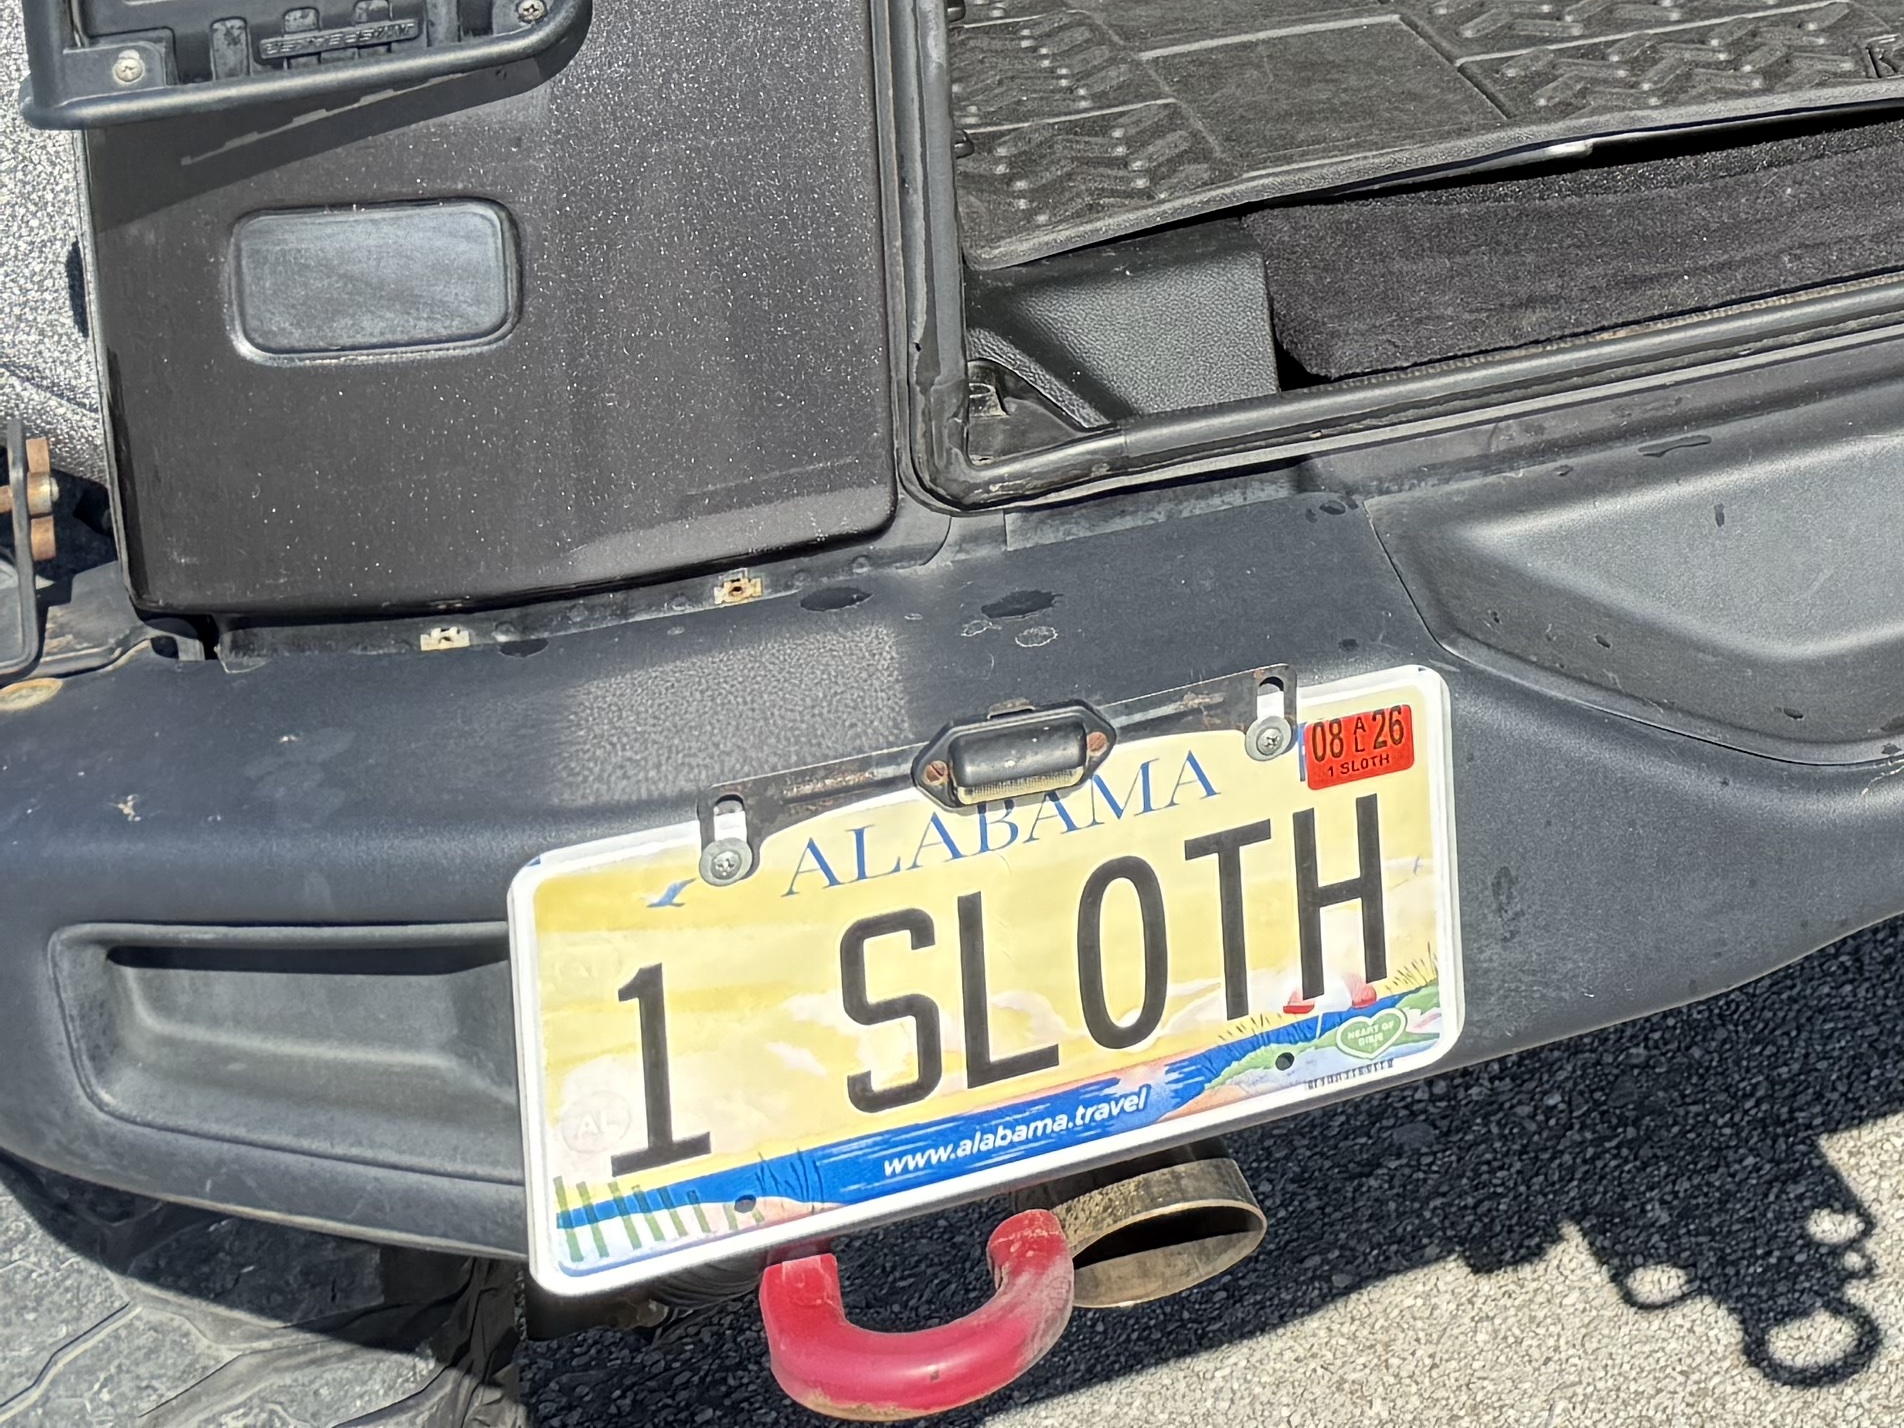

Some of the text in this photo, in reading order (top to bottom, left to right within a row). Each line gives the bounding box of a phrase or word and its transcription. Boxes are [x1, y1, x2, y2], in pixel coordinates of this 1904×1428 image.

[1312, 717, 1344, 762] 08
[1372, 704, 1404, 749] 26
[1327, 753, 1390, 777] 1 SLOTH
[785, 749, 1222, 897] ALABAMA
[610, 794, 1390, 1176] 1 SLOTH
[883, 1086, 1148, 1177] www.alabama.travel
